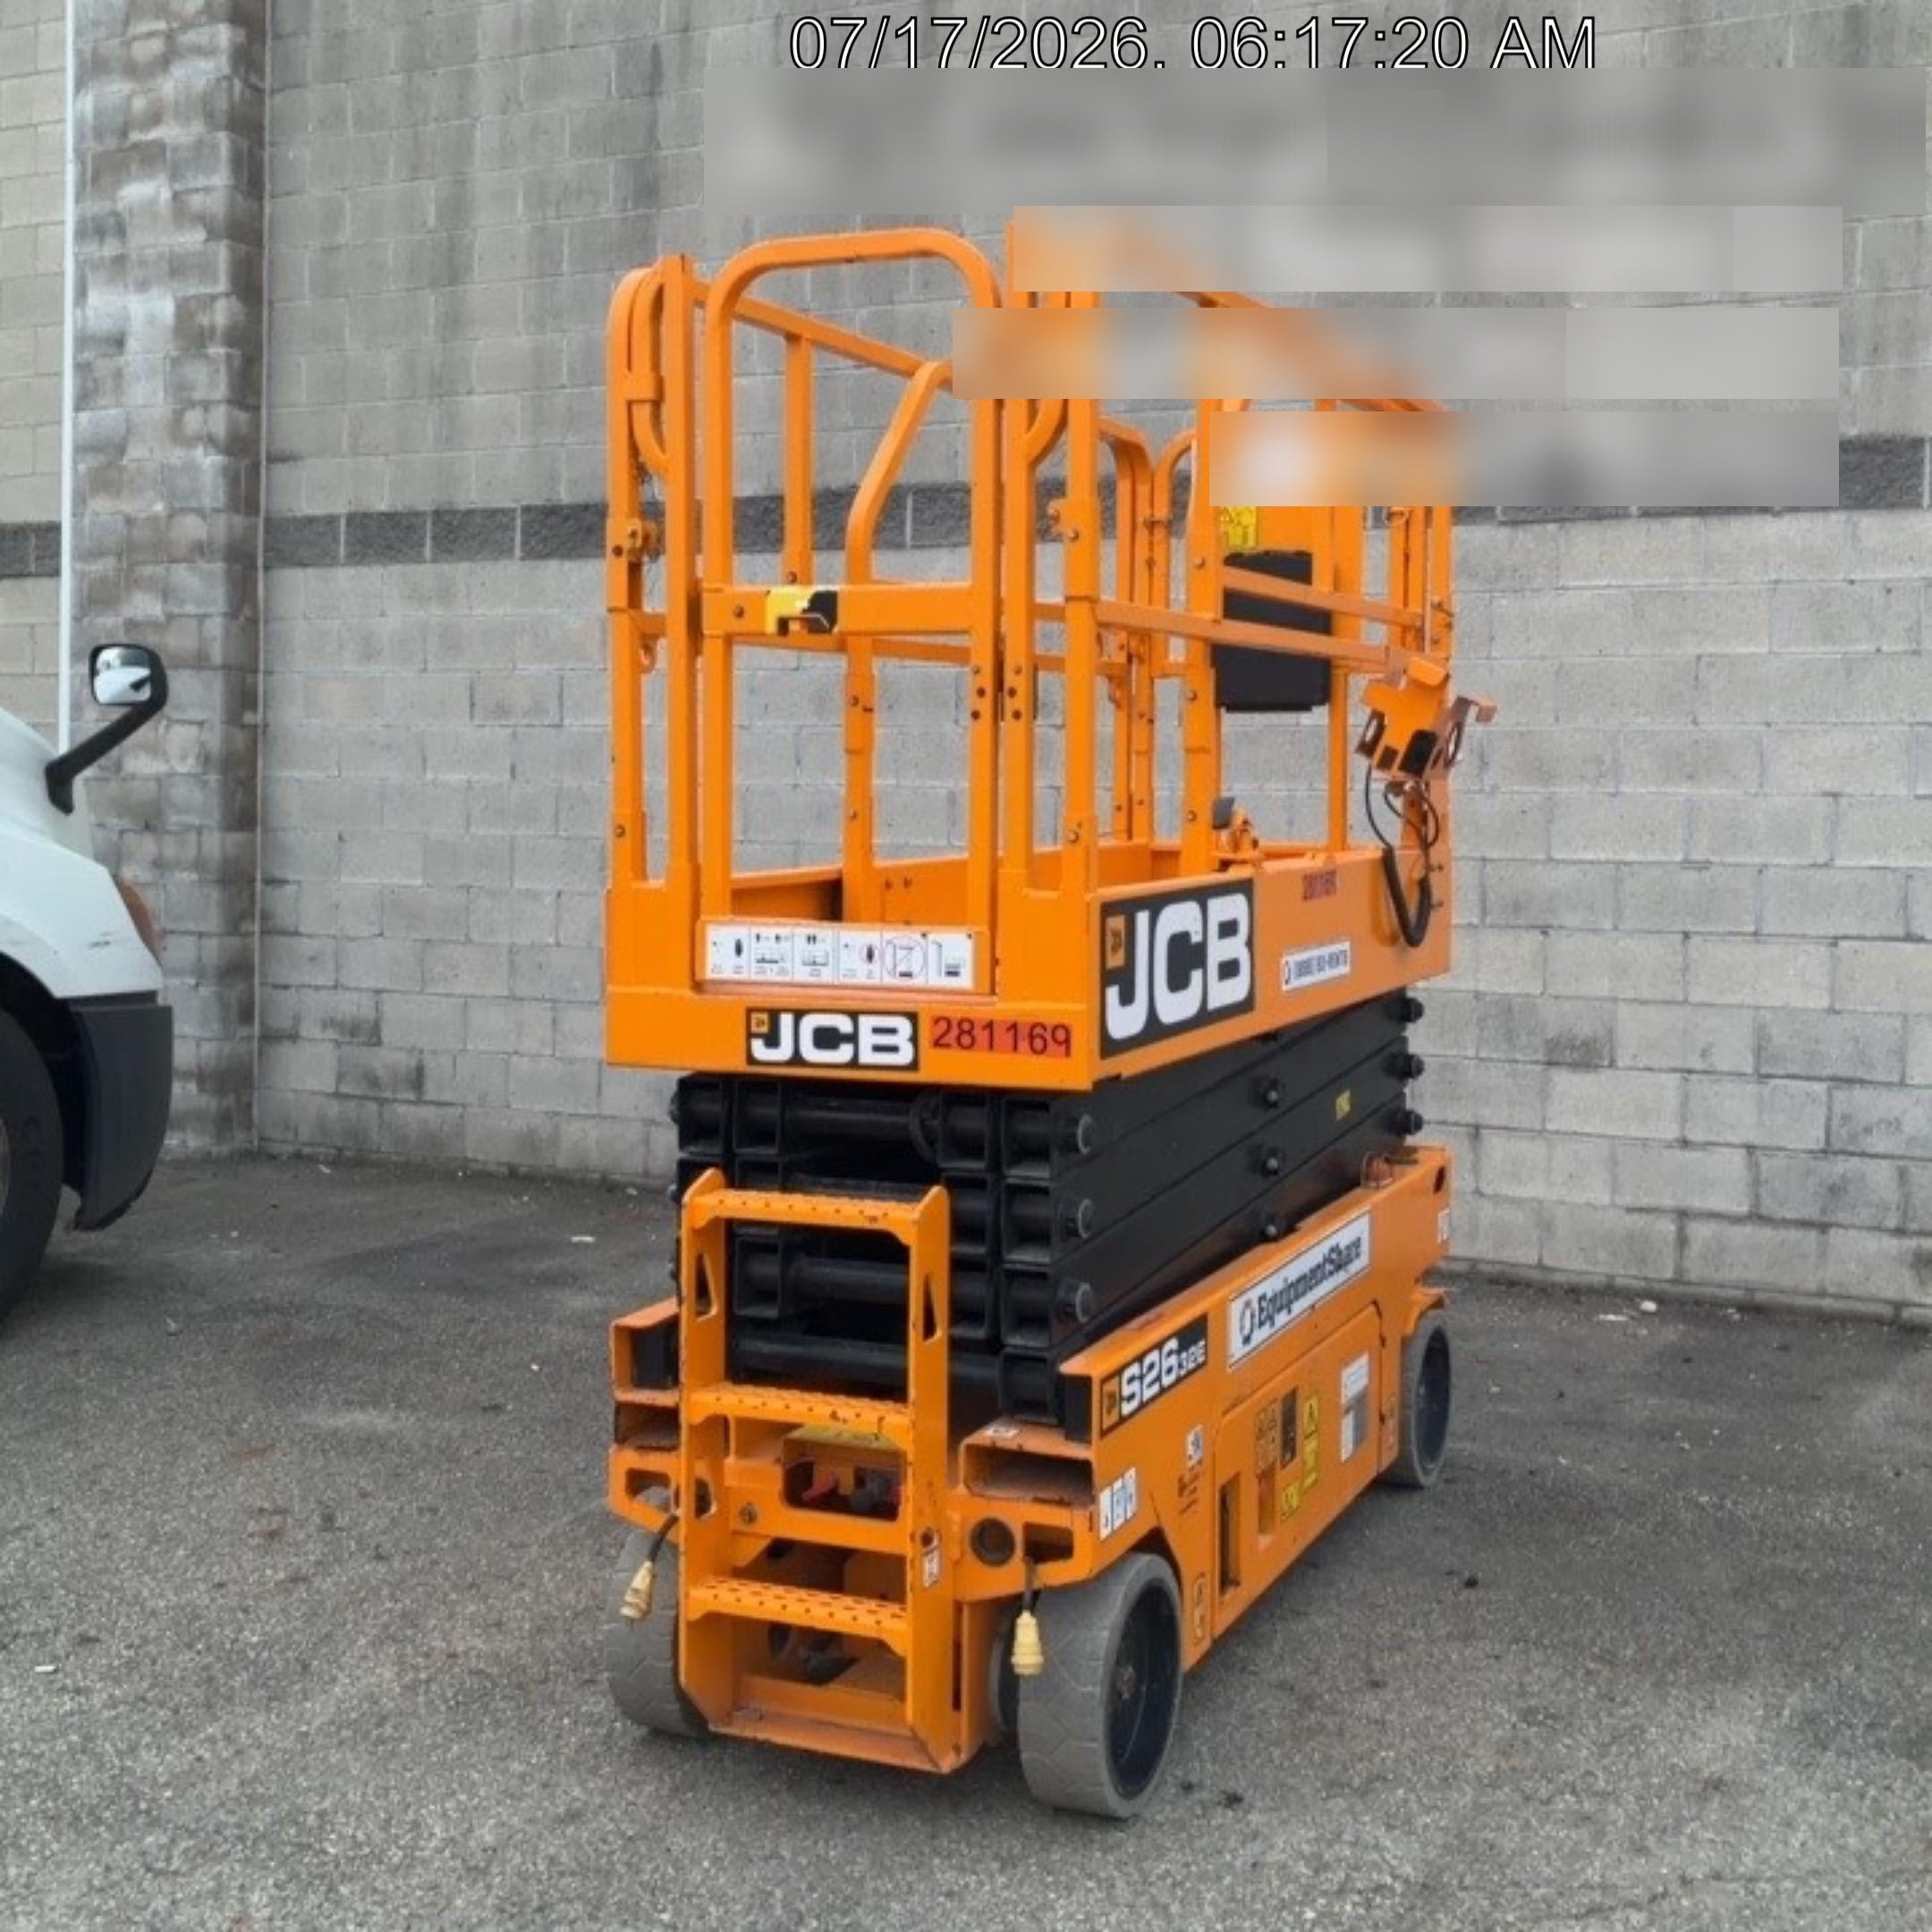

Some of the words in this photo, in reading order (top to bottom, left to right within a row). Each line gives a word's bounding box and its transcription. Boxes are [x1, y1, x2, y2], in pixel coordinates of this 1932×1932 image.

[1106, 894, 1251, 1040] JCB
[750, 1012, 914, 1066] JCB
[933, 1016, 1072, 1057] 281169
[1258, 1237, 1361, 1329] EquipmentShare
